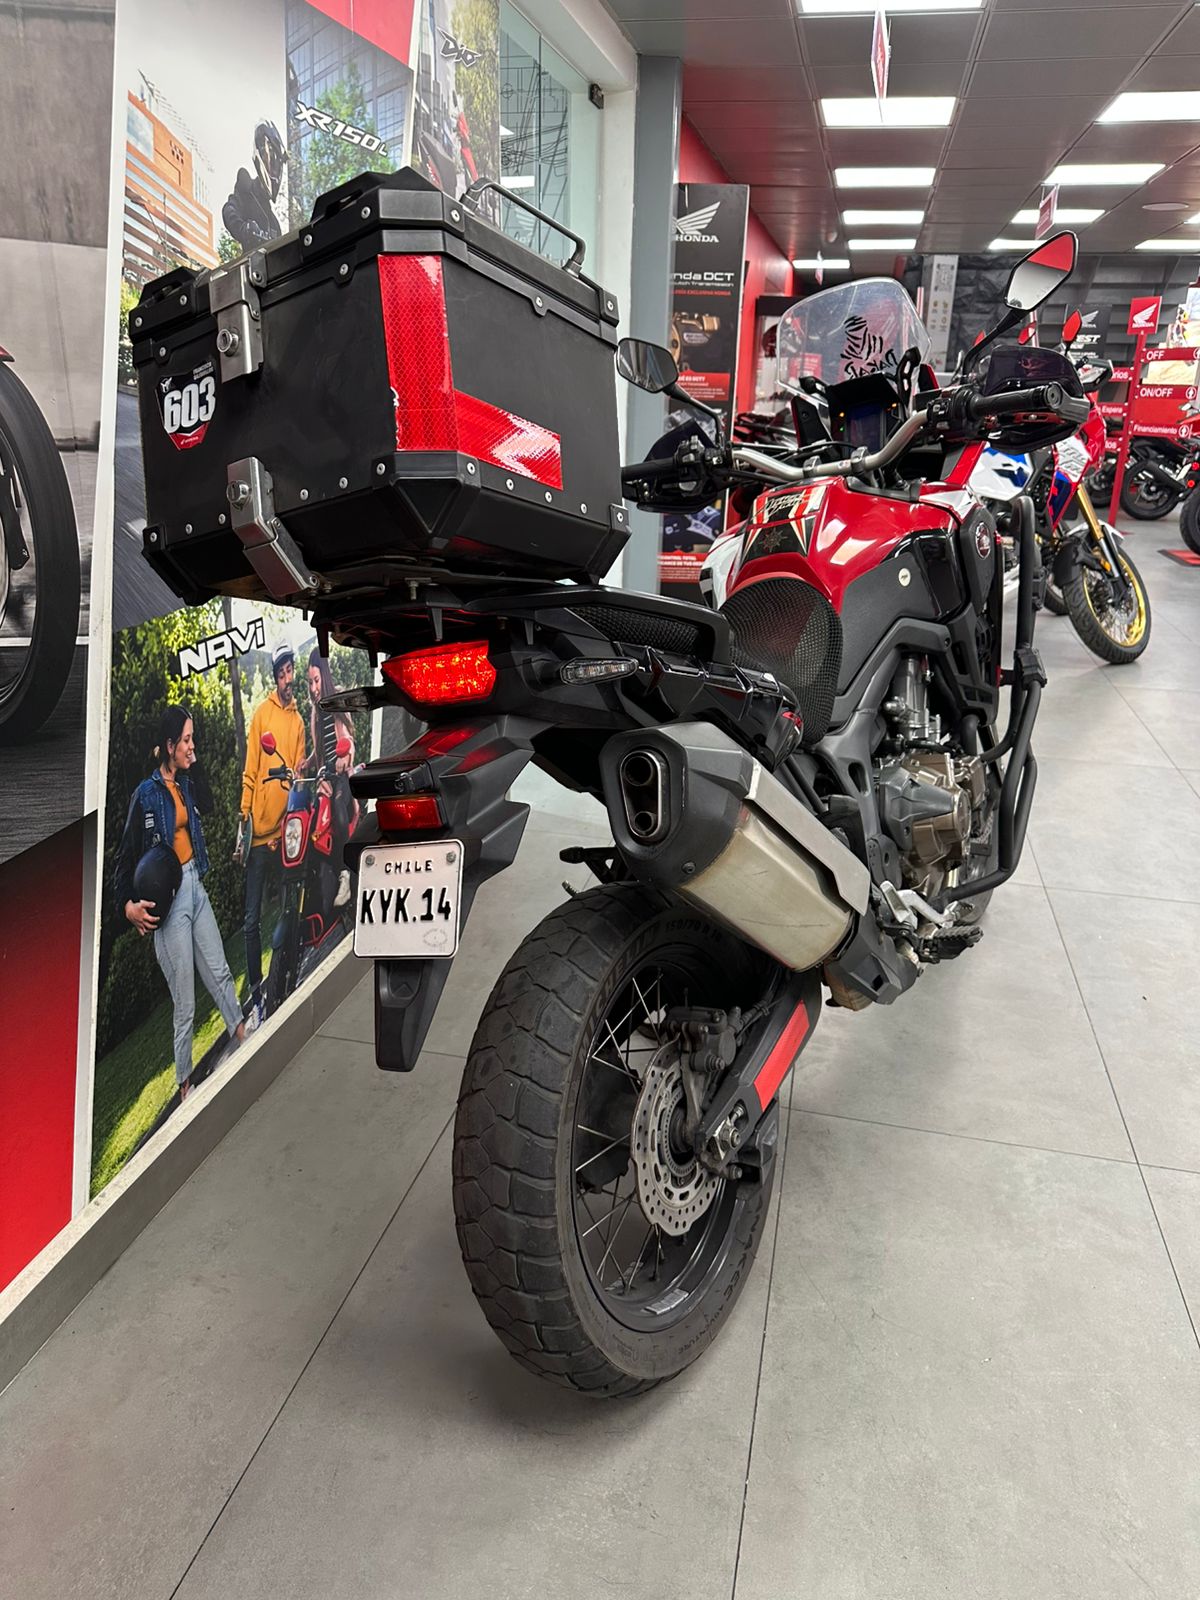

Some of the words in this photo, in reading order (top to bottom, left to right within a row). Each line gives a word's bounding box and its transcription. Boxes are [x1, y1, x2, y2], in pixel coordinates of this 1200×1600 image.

[675, 234, 720, 243] HONDA
[672, 271, 702, 281] nda
[703, 272, 735, 281] DCT
[1146, 350, 1165, 361] OFF
[1112, 369, 1129, 380] rios
[1139, 387, 1174, 398] ON/OFF
[164, 376, 216, 434] 603
[1101, 405, 1123, 415] Espera
[1133, 424, 1178, 435] Financiamiento
[384, 860, 433, 874] CHILE
[360, 887, 452, 925] KYK.14
